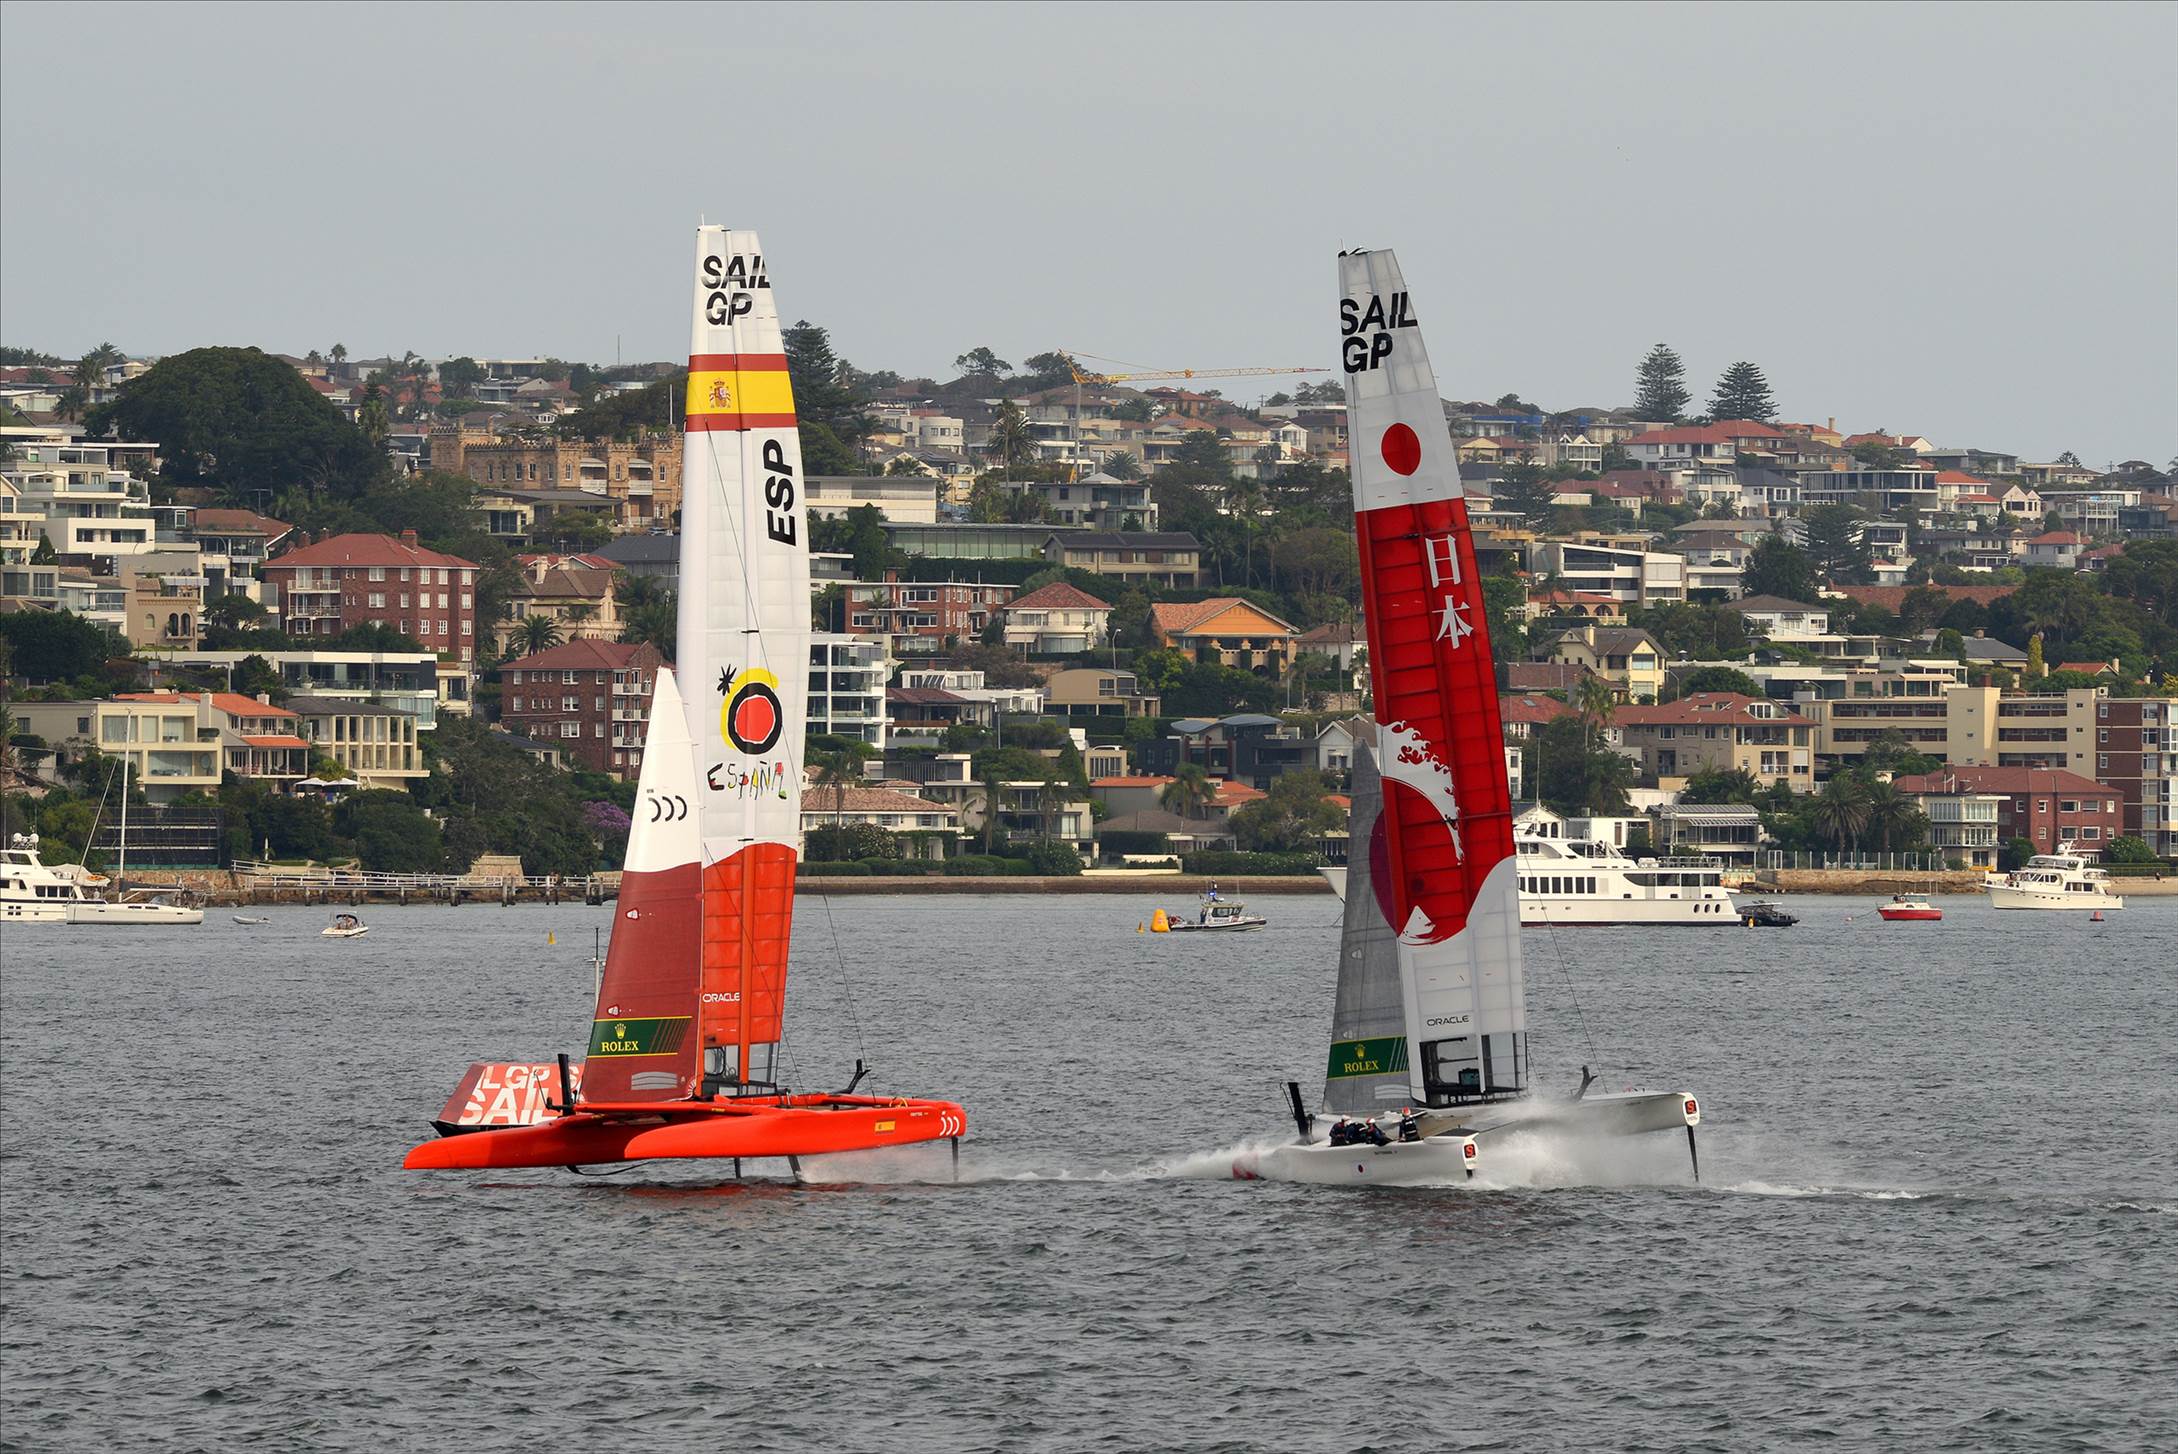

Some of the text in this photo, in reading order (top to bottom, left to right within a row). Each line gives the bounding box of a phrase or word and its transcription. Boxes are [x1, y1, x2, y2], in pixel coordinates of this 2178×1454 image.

[701, 255, 771, 289] SAIL
[705, 291, 753, 326] GP
[1340, 291, 1418, 336] SAIL
[1342, 332, 1393, 374] GP
[763, 439, 796, 546] ESP
[1425, 534, 1474, 649] 日本
[702, 992, 740, 1003] ORACLE
[1426, 1014, 1470, 1027] ORACLE
[601, 1040, 639, 1052] ROLEX
[1344, 1060, 1379, 1073] ROLEX
